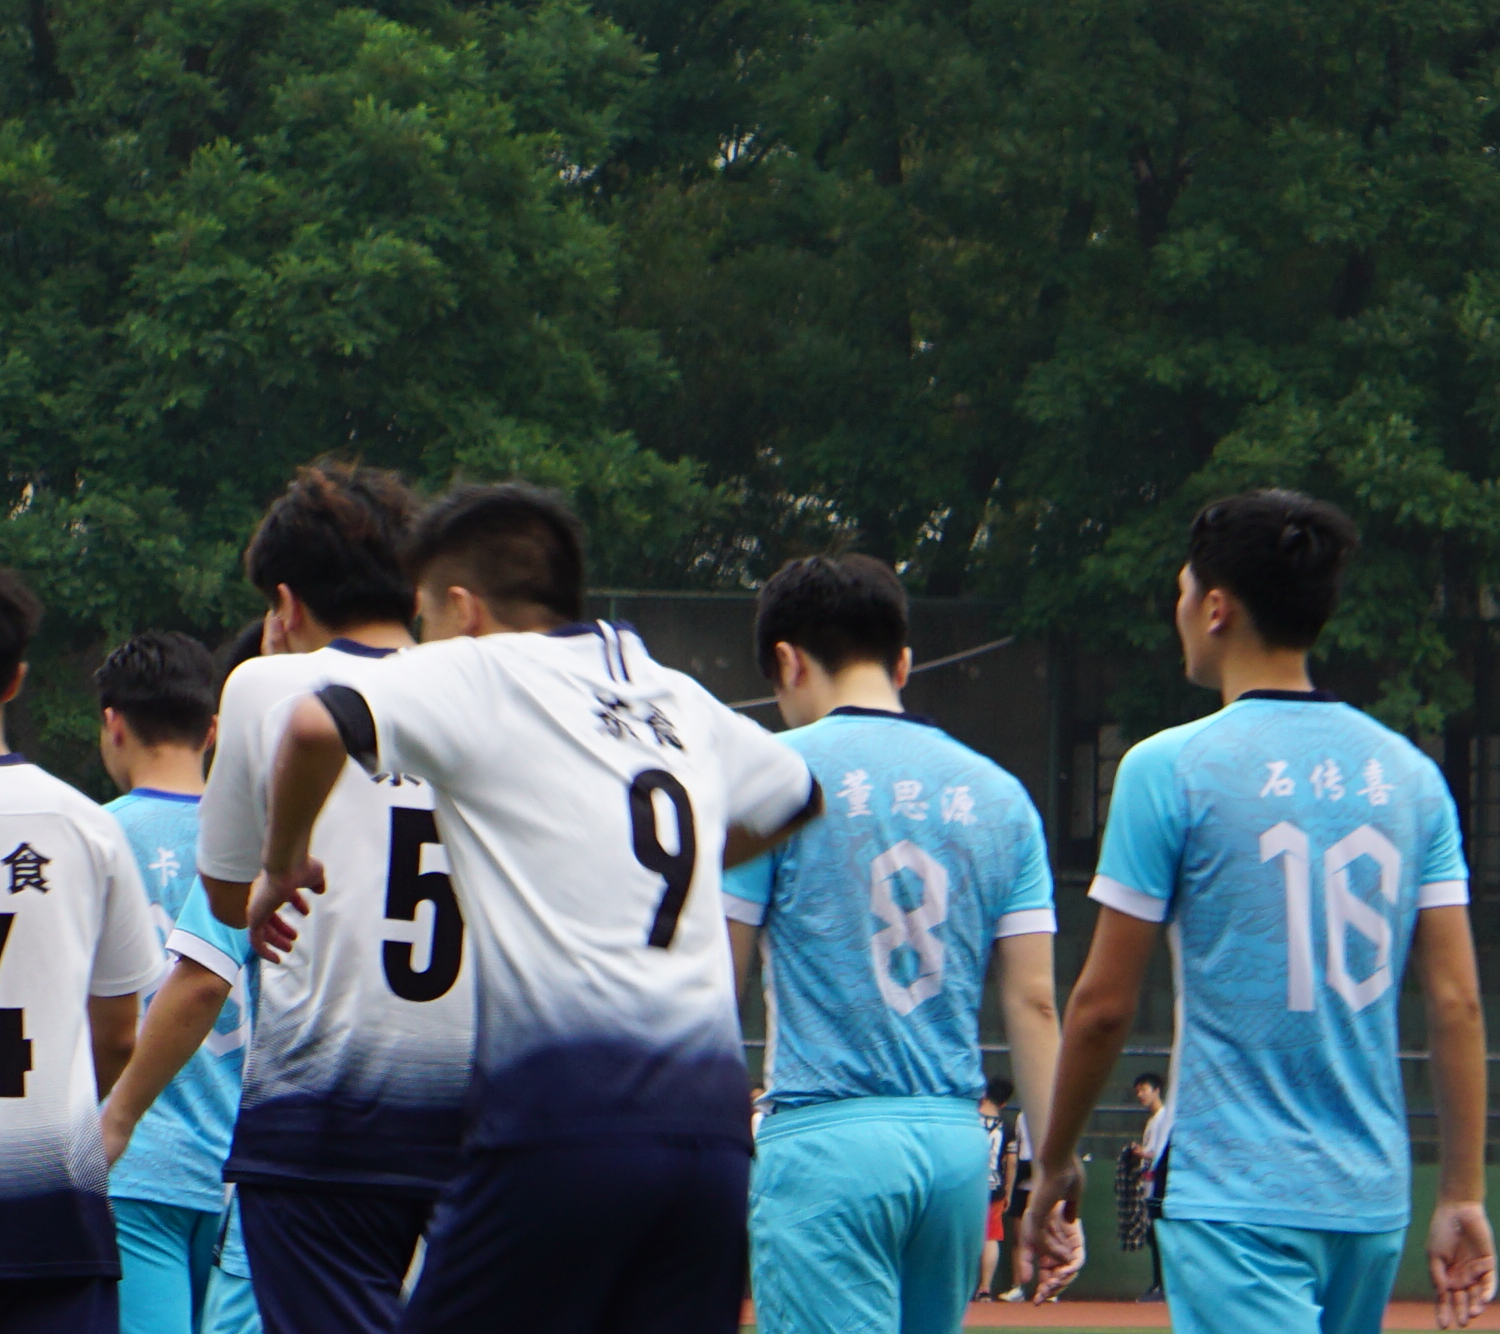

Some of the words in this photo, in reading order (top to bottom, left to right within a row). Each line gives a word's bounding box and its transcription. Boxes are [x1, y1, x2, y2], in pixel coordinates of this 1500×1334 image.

[382, 806, 464, 1003] 5
[629, 768, 697, 950] 9
[870, 839, 949, 1017] 8
[1259, 821, 1400, 1012] 16
